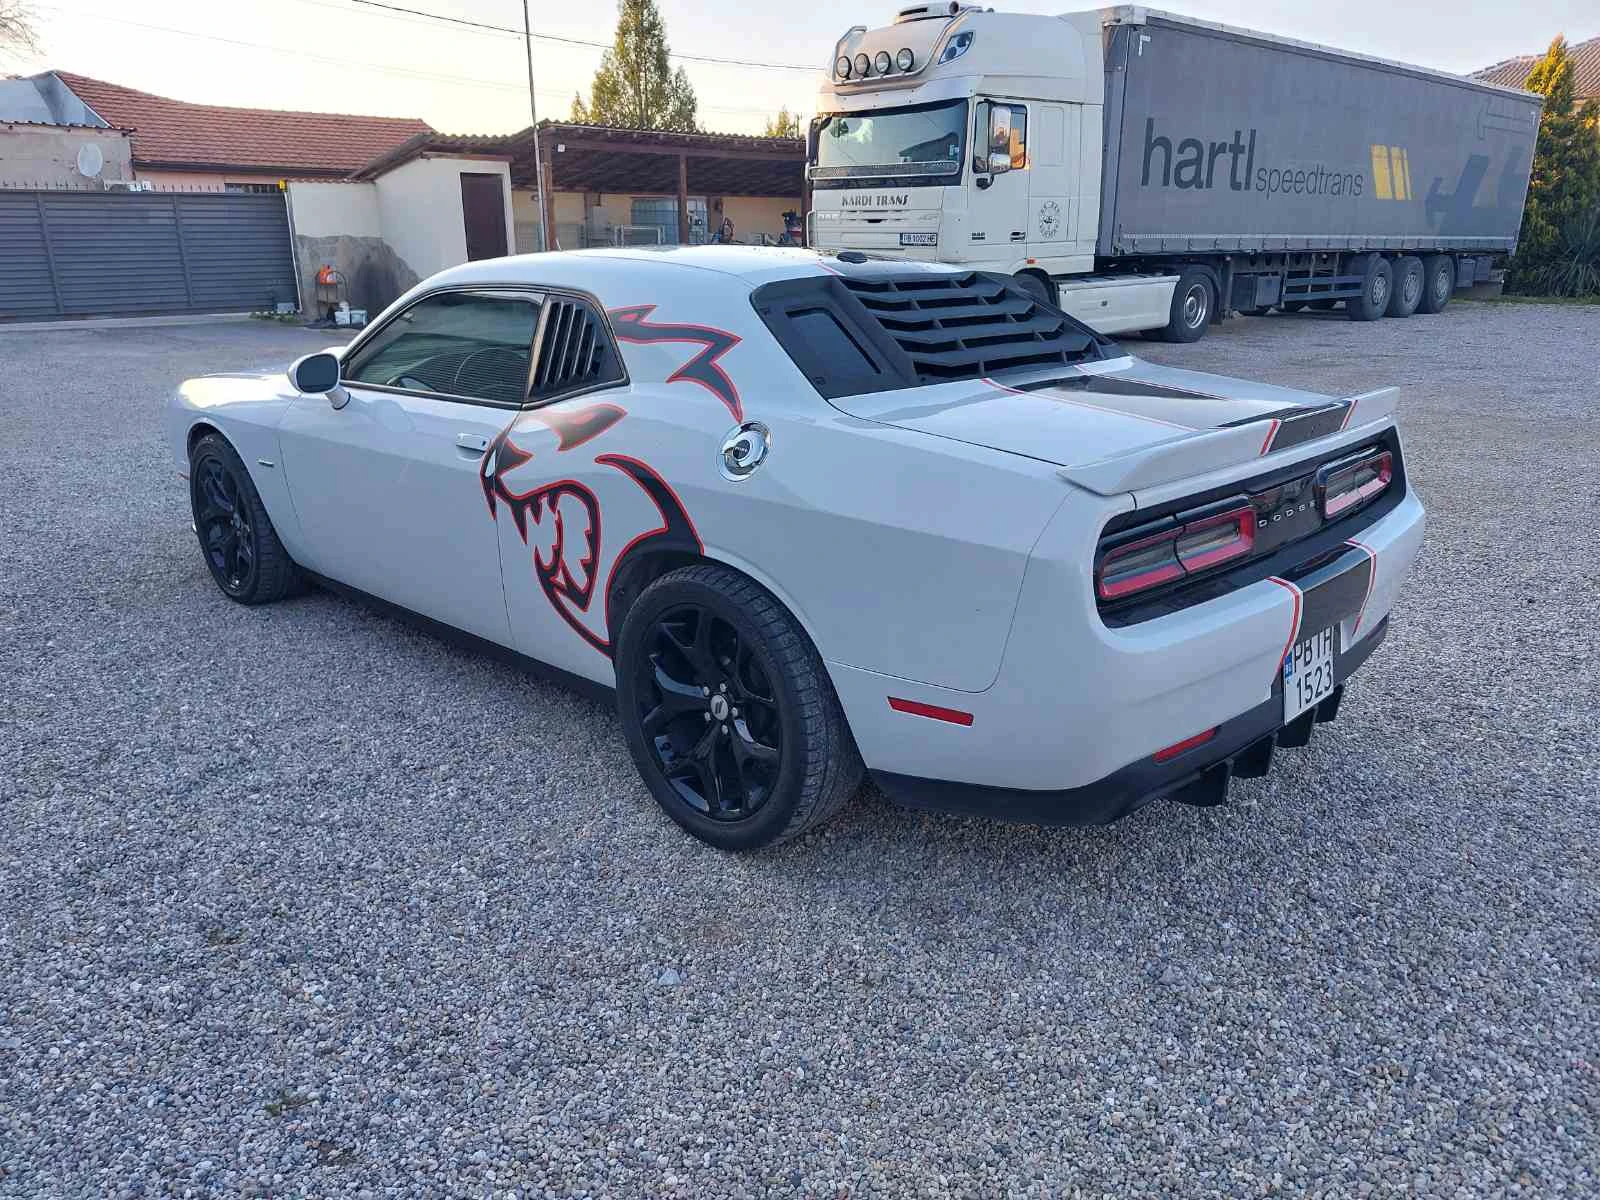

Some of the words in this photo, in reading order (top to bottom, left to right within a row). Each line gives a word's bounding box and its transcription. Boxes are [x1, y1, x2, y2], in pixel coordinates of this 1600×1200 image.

[1141, 117, 1257, 191] hartl
[1255, 163, 1364, 201] speedtrans
[876, 194, 909, 206] TRANS
[1258, 500, 1316, 527] DODGE
[1296, 660, 1332, 709] 1523
